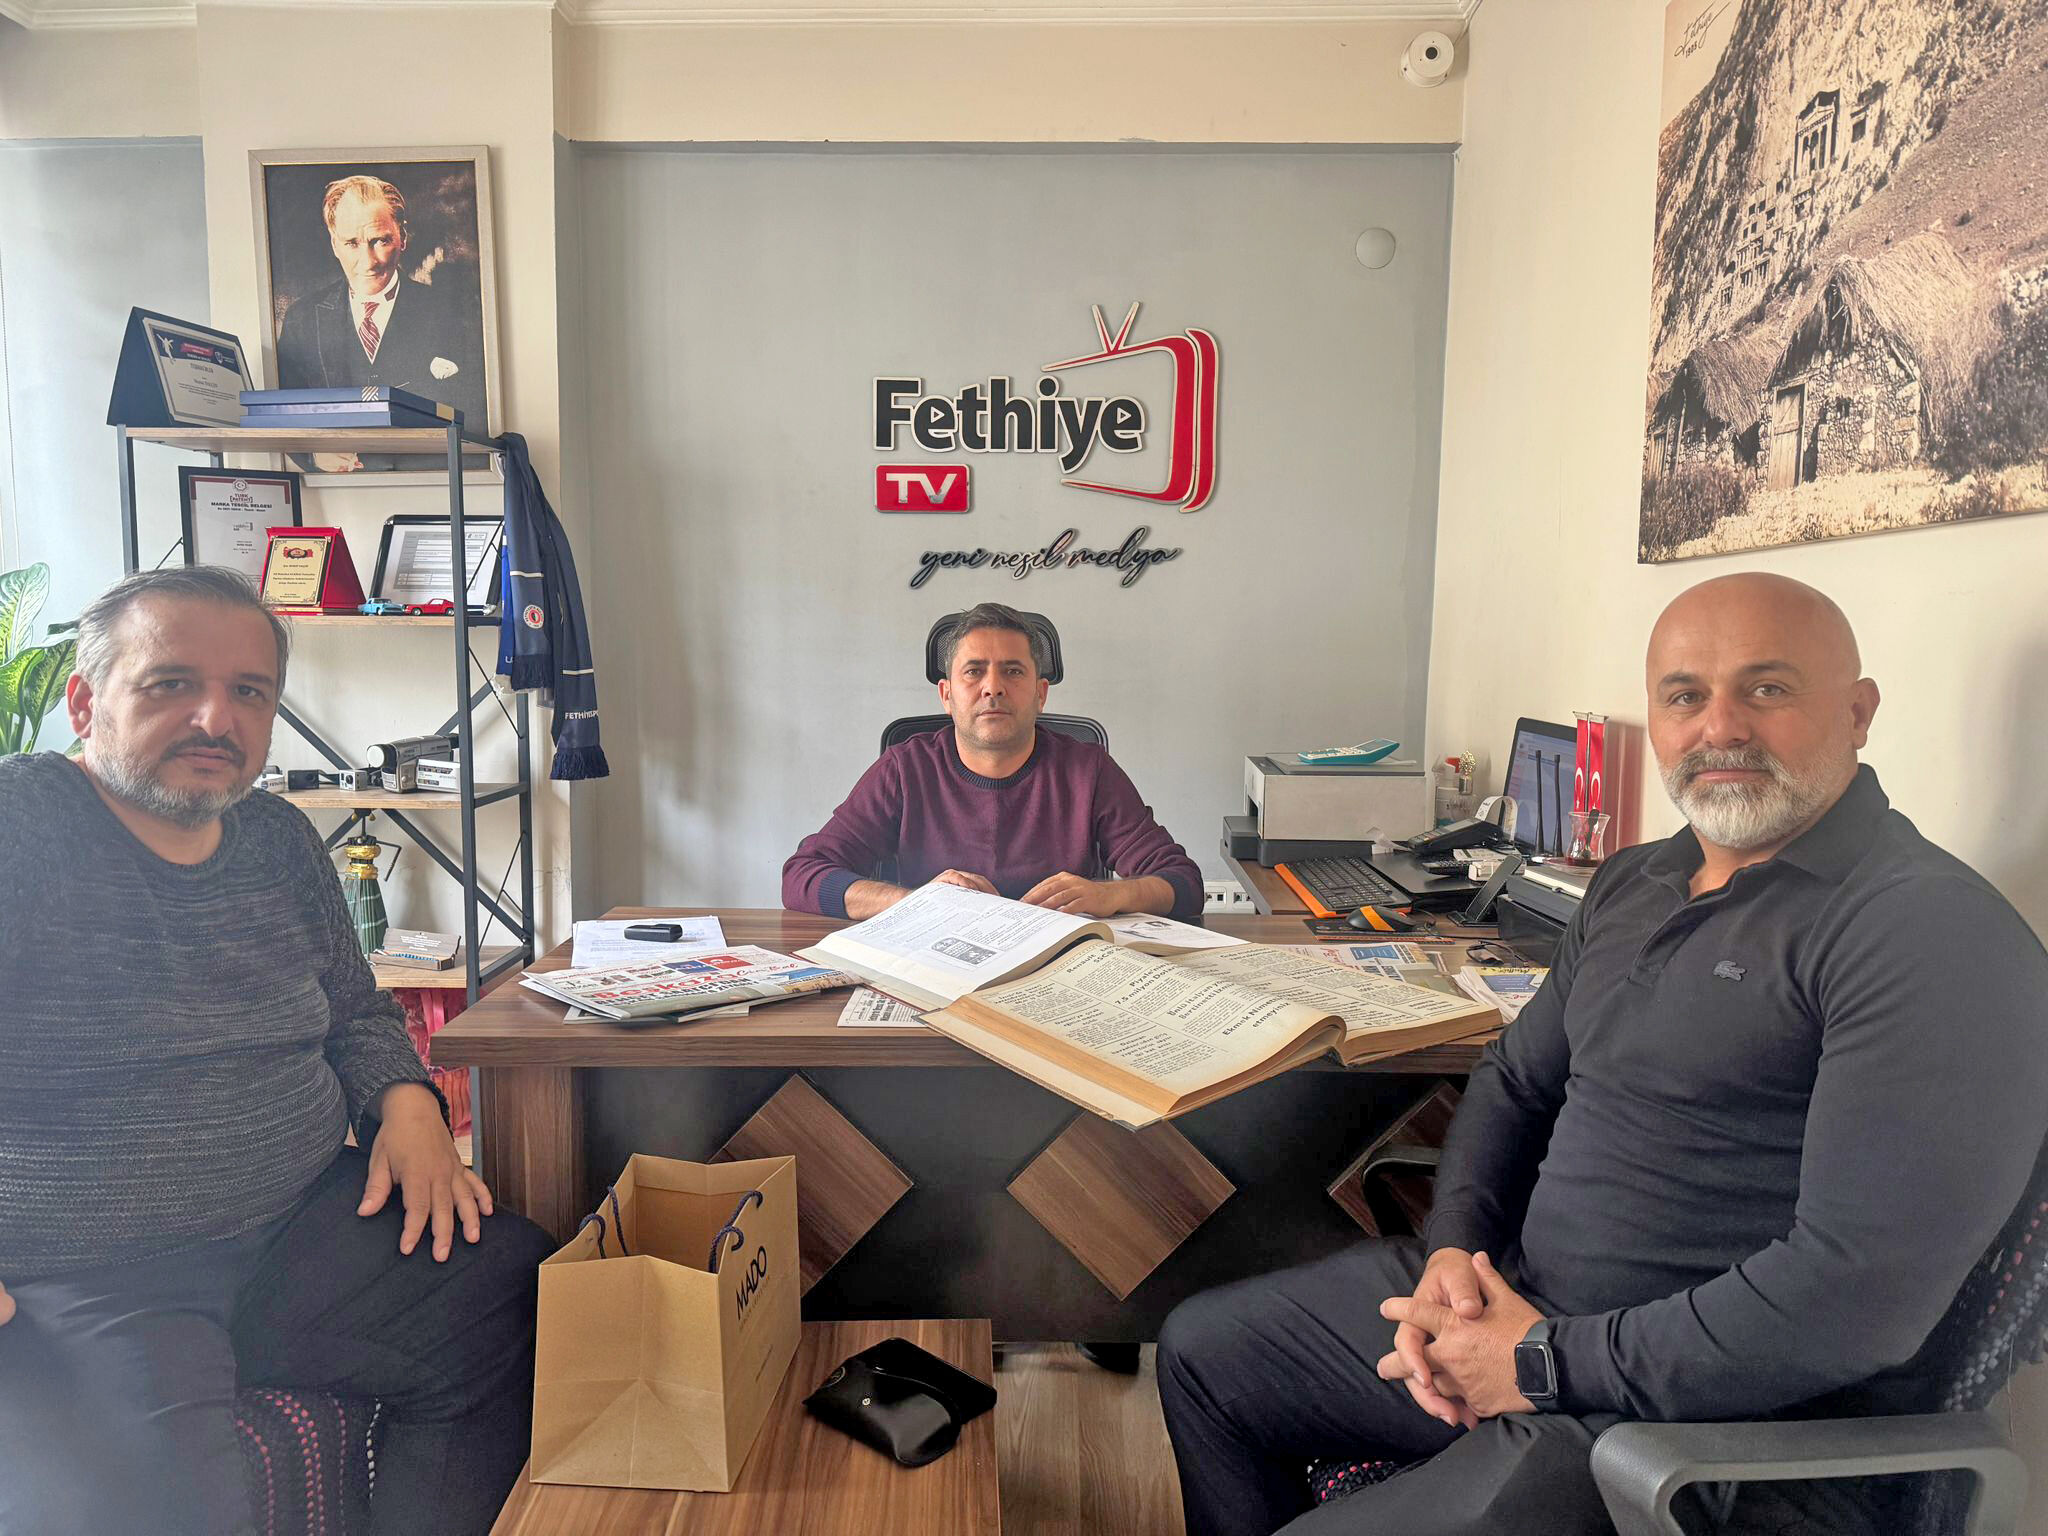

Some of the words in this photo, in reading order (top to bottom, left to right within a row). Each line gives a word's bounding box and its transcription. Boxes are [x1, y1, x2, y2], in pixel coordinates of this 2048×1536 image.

[874, 377, 1145, 472] Fethiye
[885, 473, 957, 503] TV
[911, 548, 990, 588] yeni
[1066, 525, 1177, 588] medya
[1066, 954, 1097, 974] Renault
[1128, 979, 1155, 998] milyon
[1222, 1015, 1251, 1037] Ekmek
[736, 1247, 767, 1320] MADO
